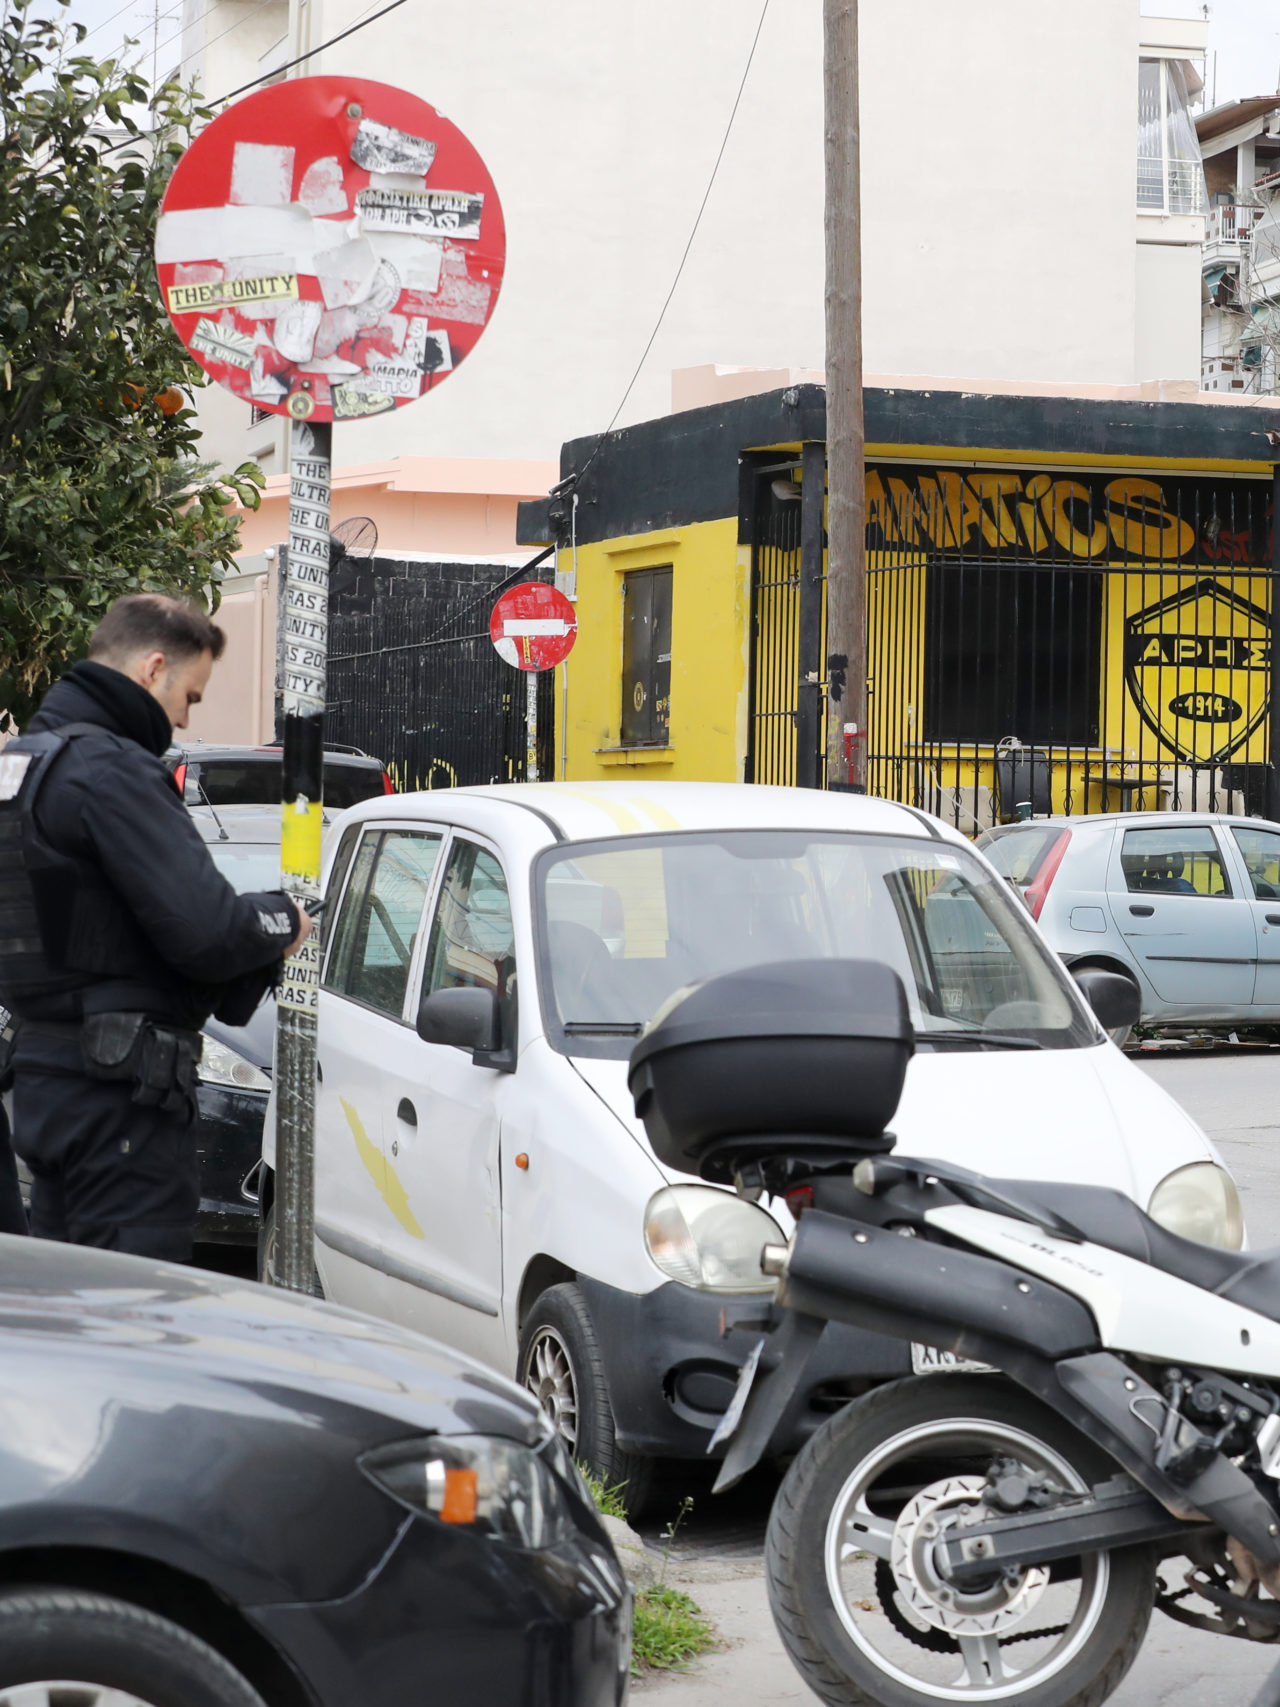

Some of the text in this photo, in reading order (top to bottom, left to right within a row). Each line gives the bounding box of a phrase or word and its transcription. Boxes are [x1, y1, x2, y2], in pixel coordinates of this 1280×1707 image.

[170, 274, 294, 305] THE UNITY
[296, 462, 327, 479] THE
[1138, 637, 1271, 668] ΑΡΗΣ
